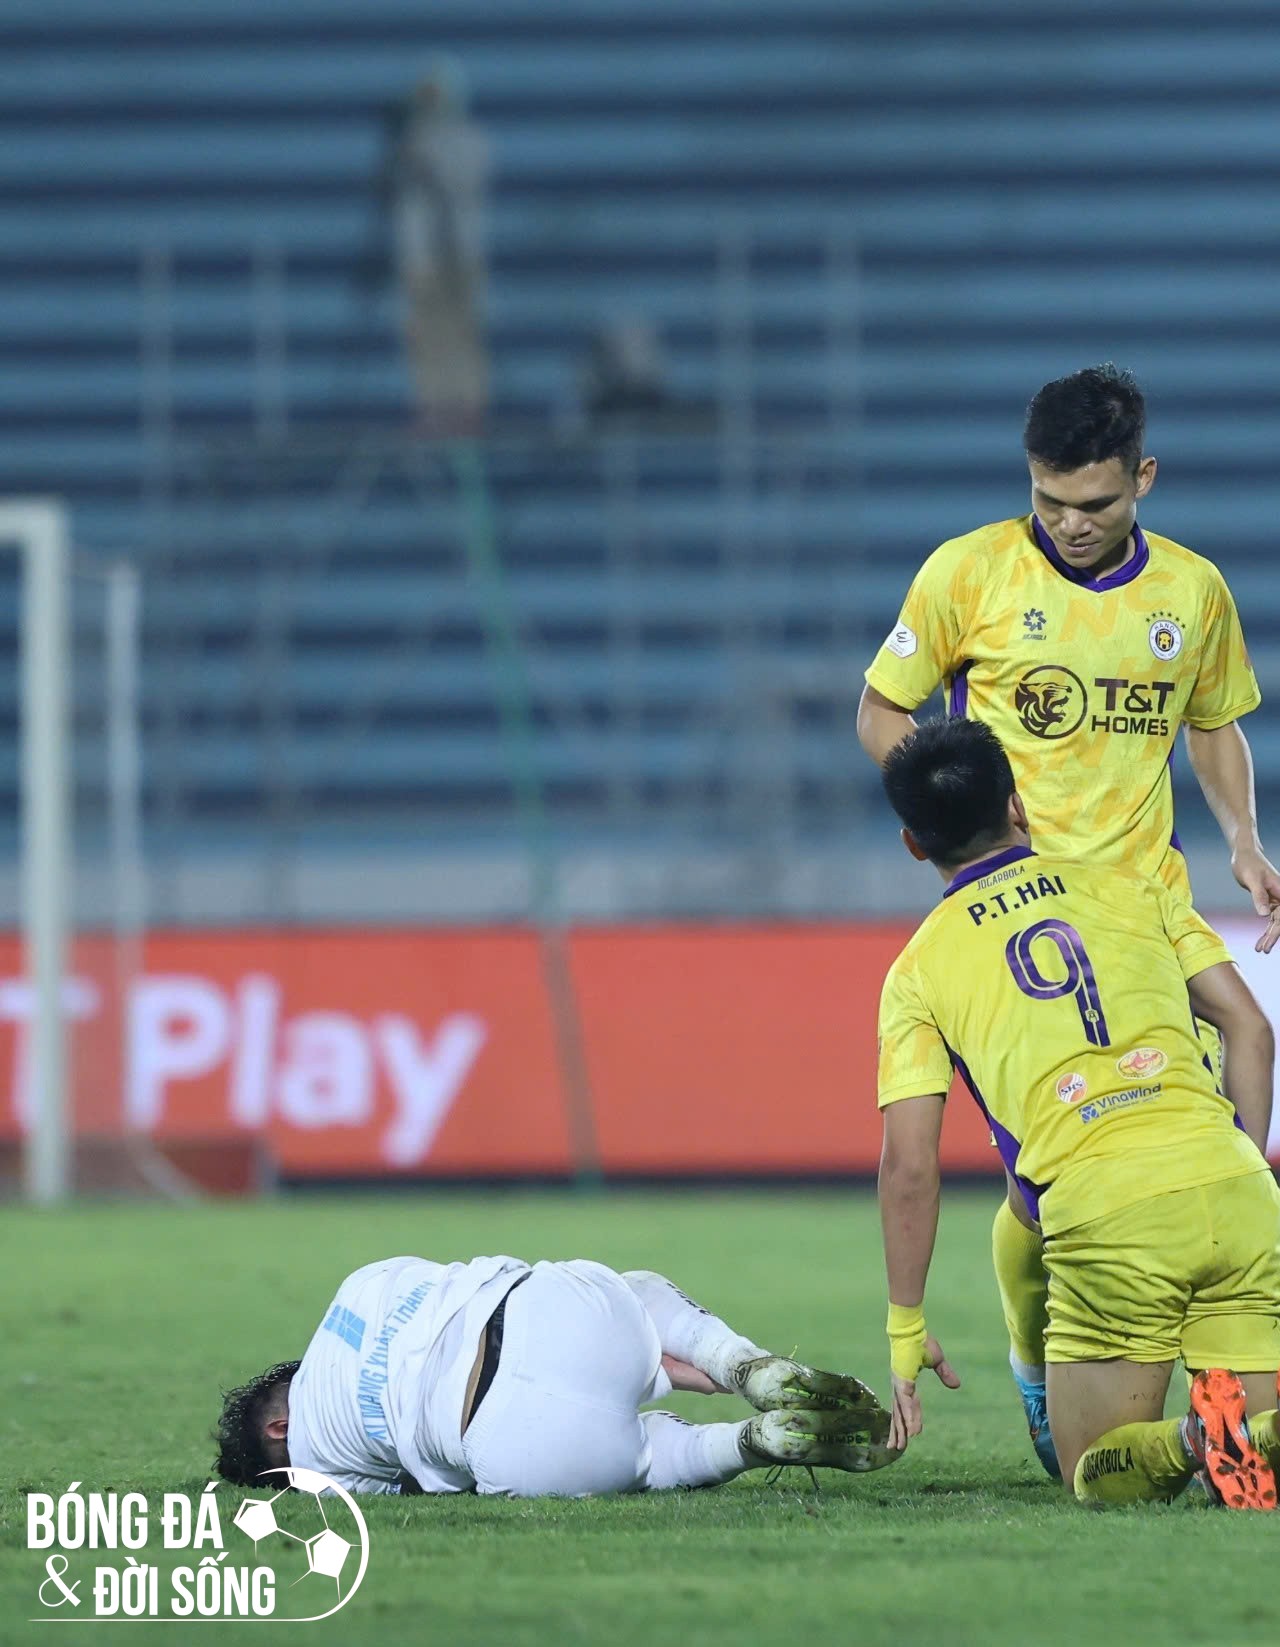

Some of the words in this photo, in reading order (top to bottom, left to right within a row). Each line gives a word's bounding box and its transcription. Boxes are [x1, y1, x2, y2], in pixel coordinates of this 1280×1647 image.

[1095, 677, 1176, 714] T&T
[1091, 715, 1169, 737] HOMES
[977, 865, 1025, 891] JOGARBOLA
[1005, 918, 1111, 1048] 9
[123, 970, 487, 1166] Play
